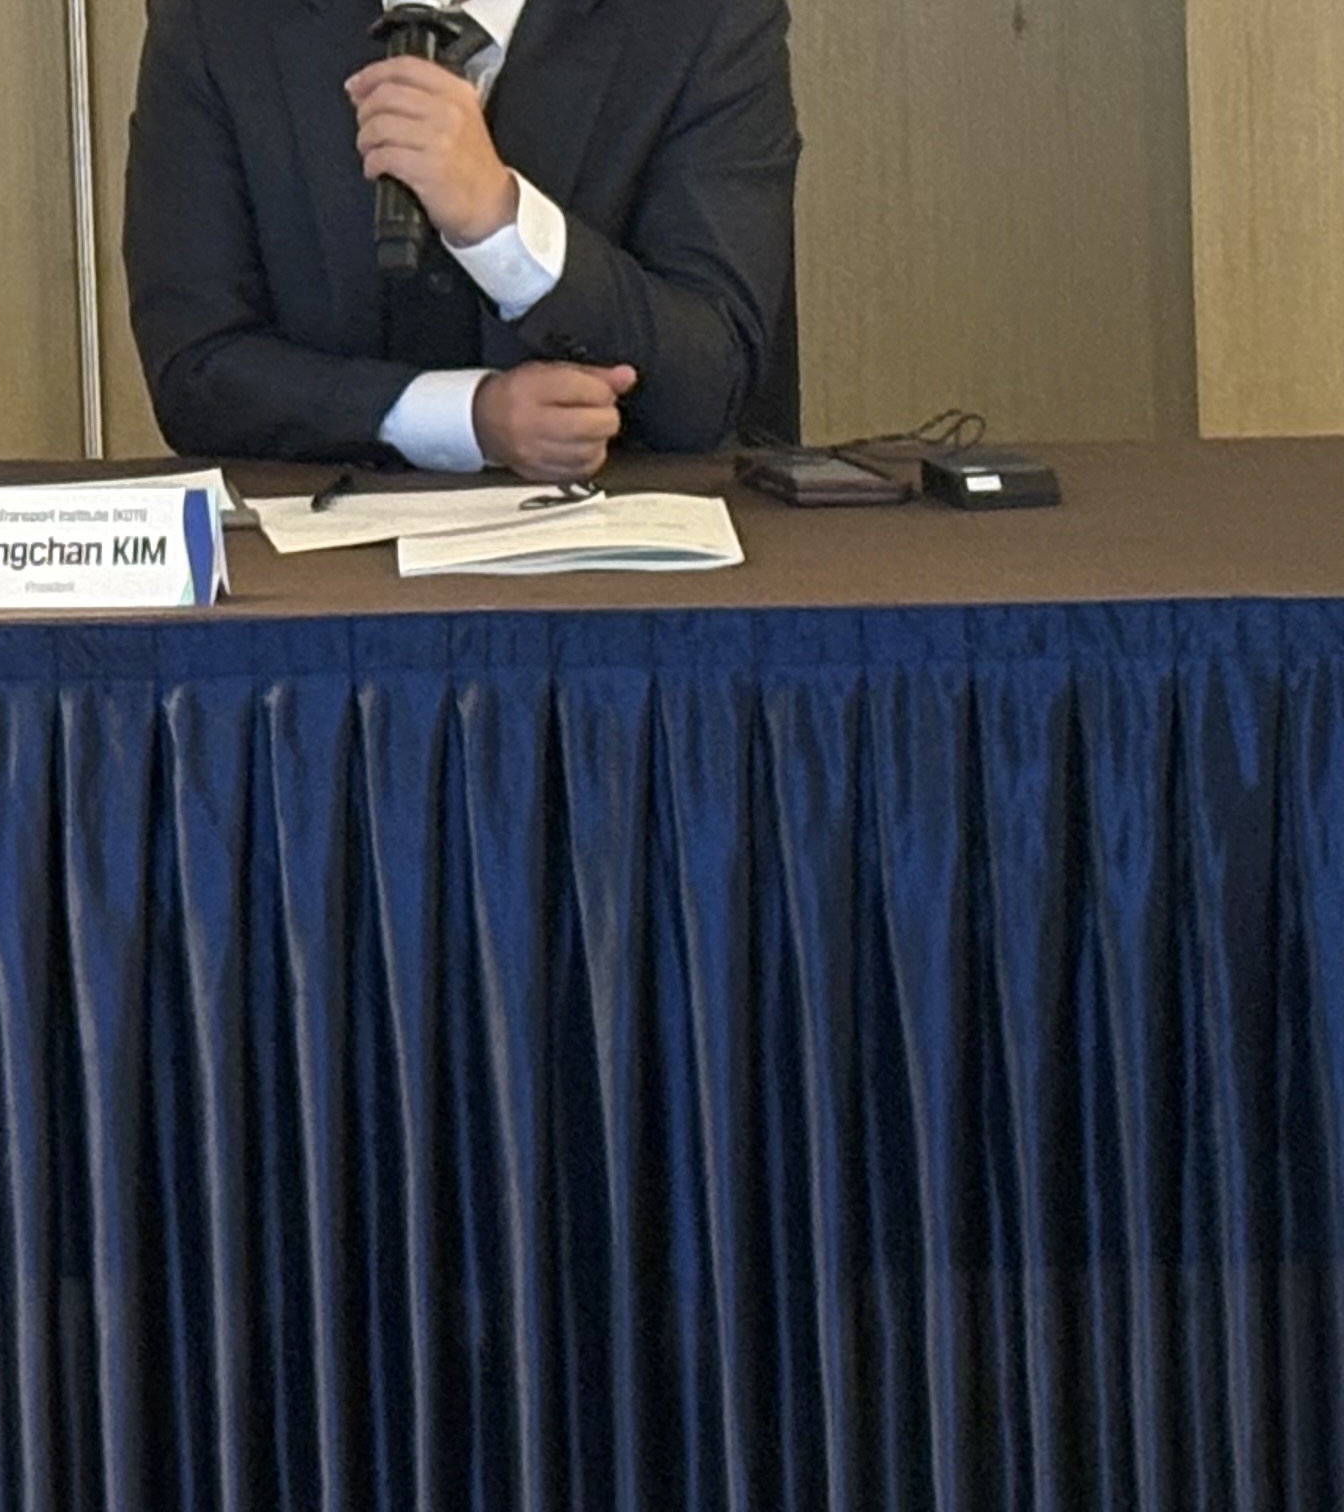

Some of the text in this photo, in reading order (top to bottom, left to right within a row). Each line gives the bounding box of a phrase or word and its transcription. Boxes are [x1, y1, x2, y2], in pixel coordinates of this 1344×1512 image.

[0, 508, 55, 522] Transport
[59, 508, 109, 522] Institute
[113, 536, 166, 566] KIM
